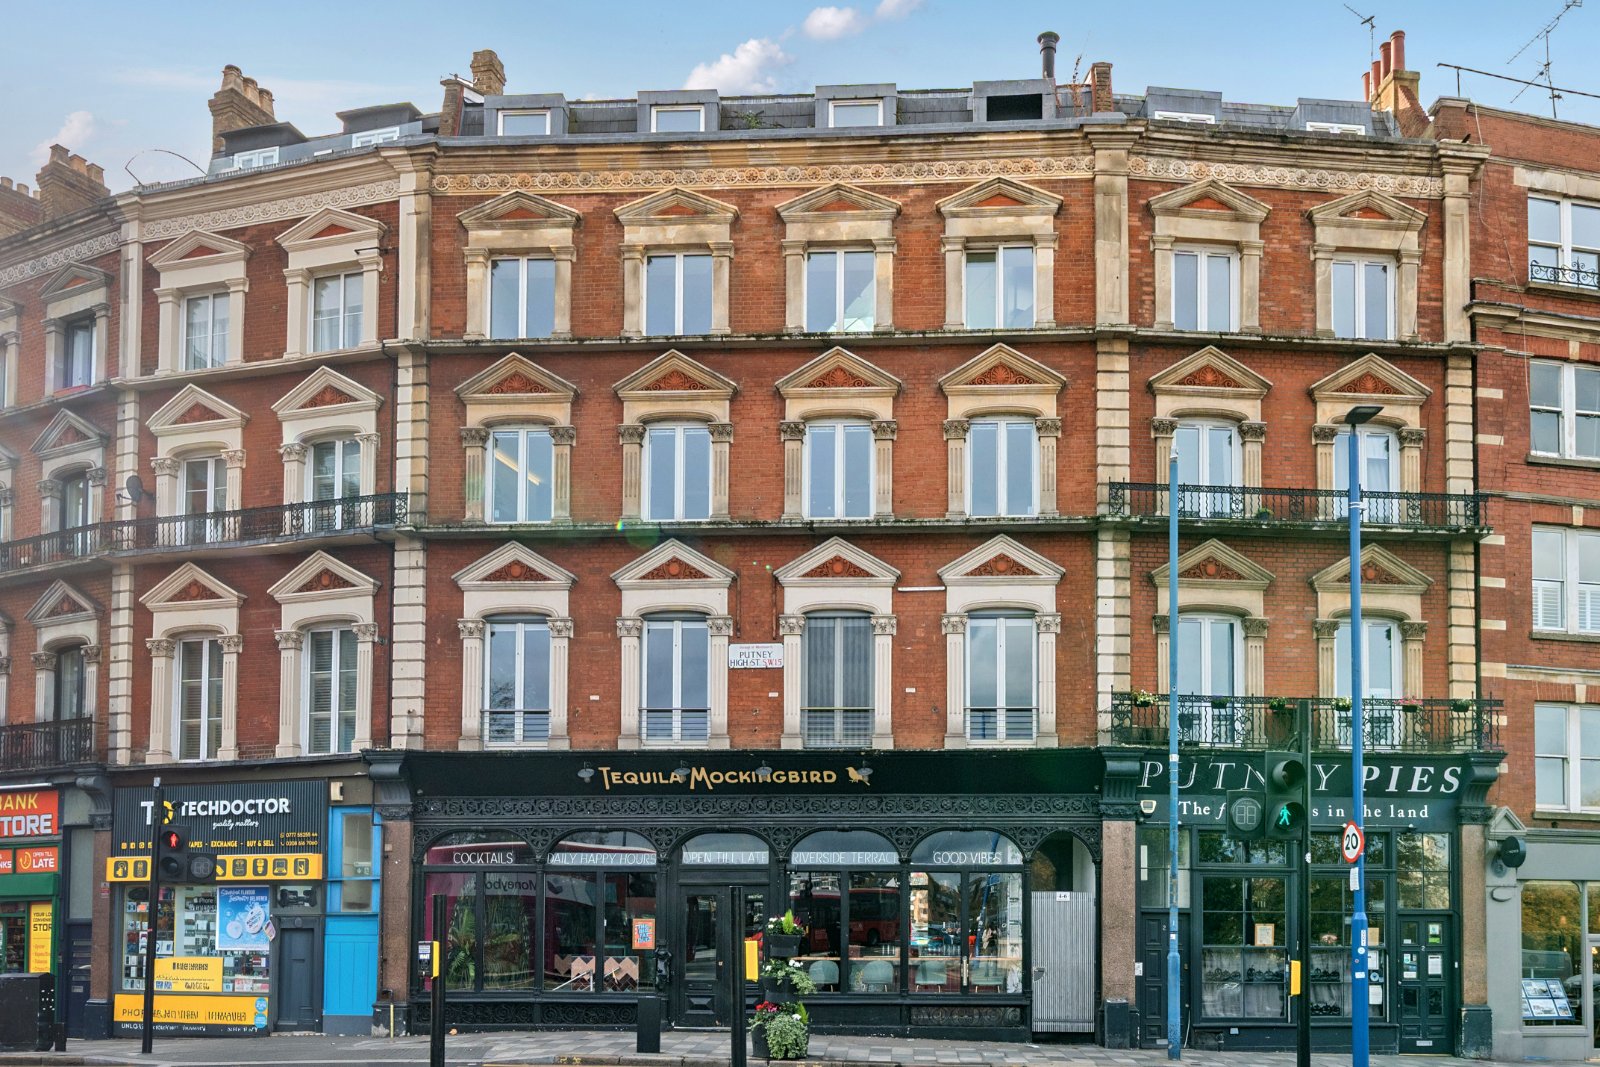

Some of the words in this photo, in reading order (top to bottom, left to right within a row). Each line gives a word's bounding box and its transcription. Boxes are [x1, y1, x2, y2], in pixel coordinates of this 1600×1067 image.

[739, 651, 773, 659] PUTNEY
[730, 659, 748, 667] HIGH
[598, 767, 683, 790] TEQUILA
[1137, 761, 1341, 791] PUTNY
[1361, 765, 1462, 793] PIES
[0, 793, 38, 811] ANK
[181, 798, 291, 816] TECHDOCTOR
[1178, 801, 1211, 815] The
[1328, 805, 1345, 817] in
[1363, 804, 1382, 818] he
[1390, 804, 1429, 818] land
[0, 814, 53, 836] TORE
[212, 819, 235, 831] quality
[211, 840, 238, 848] EXCHANGE
[247, 839, 257, 847] BUY
[263, 838, 275, 847] SELL
[1345, 833, 1359, 851] 20
[33, 858, 55, 869] LATE
[453, 852, 514, 865] COCKTAILS
[547, 853, 576, 865] DAILY
[580, 853, 616, 865] HAPPY
[619, 853, 657, 865] HOURS
[683, 852, 712, 866] OPEN
[717, 852, 736, 865] TILL
[741, 852, 768, 864] LATE
[792, 852, 847, 864] RIVERSIDE
[851, 852, 900, 864] TERRACE
[933, 852, 967, 864] GOOD
[971, 852, 1002, 865] VIBES
[33, 923, 52, 931] STOR
